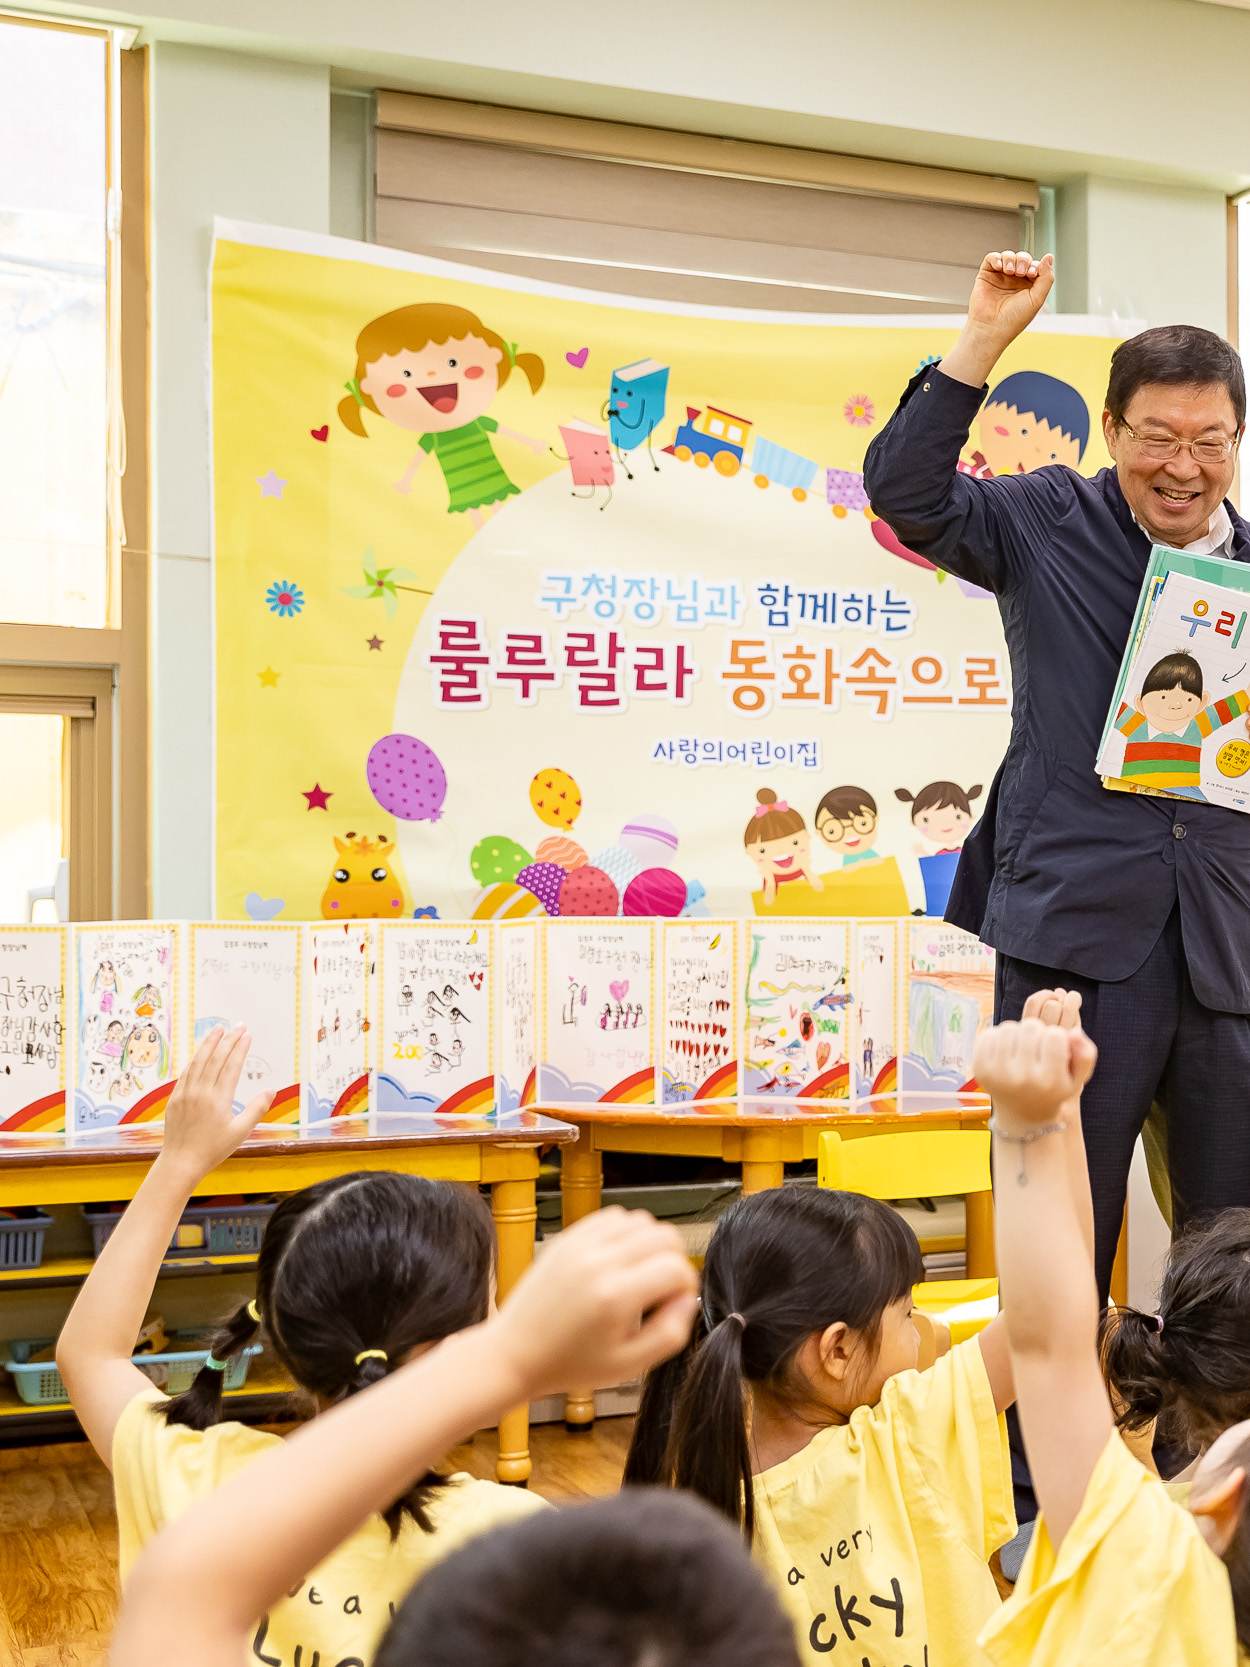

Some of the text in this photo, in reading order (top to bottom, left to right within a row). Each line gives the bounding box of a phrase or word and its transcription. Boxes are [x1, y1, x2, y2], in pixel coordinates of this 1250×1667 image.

[540, 573, 912, 632] 구청장님과 함께하는
[1181, 599, 1247, 649] 우리
[429, 619, 1008, 716] 룰루랄라 동화속으로
[787, 1524, 873, 1586] a very
[343, 1595, 362, 1614] a
